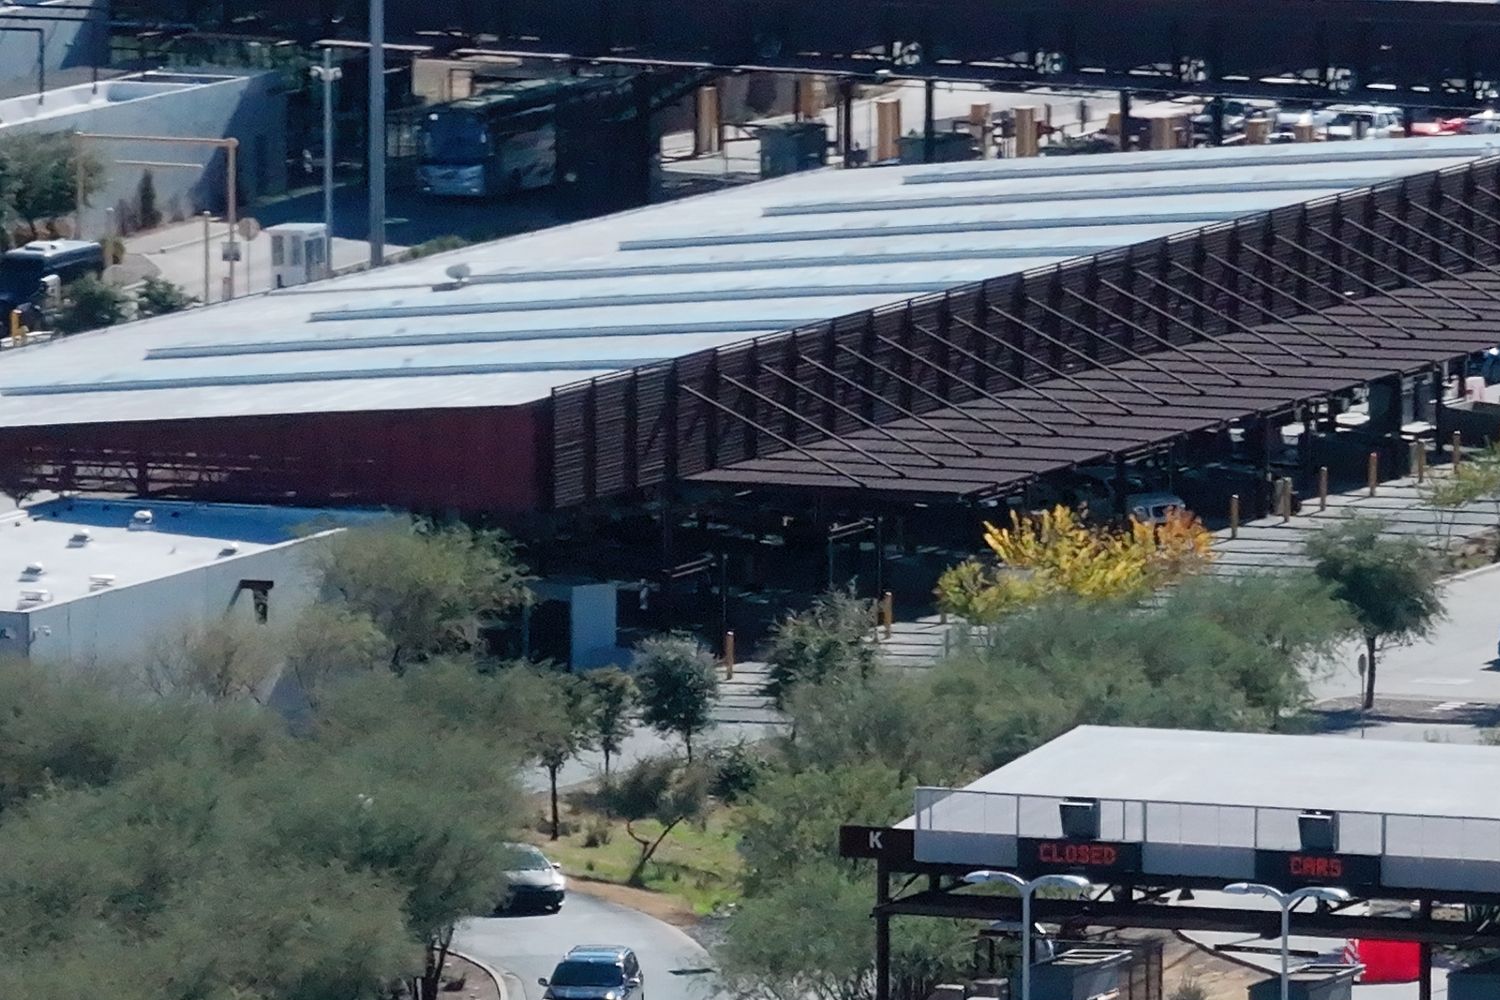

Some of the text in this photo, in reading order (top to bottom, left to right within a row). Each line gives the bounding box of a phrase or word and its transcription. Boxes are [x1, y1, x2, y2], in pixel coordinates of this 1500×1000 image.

[868, 831, 883, 849] K
[1039, 843, 1119, 865] CLOSED
[1290, 856, 1342, 877] CARS
